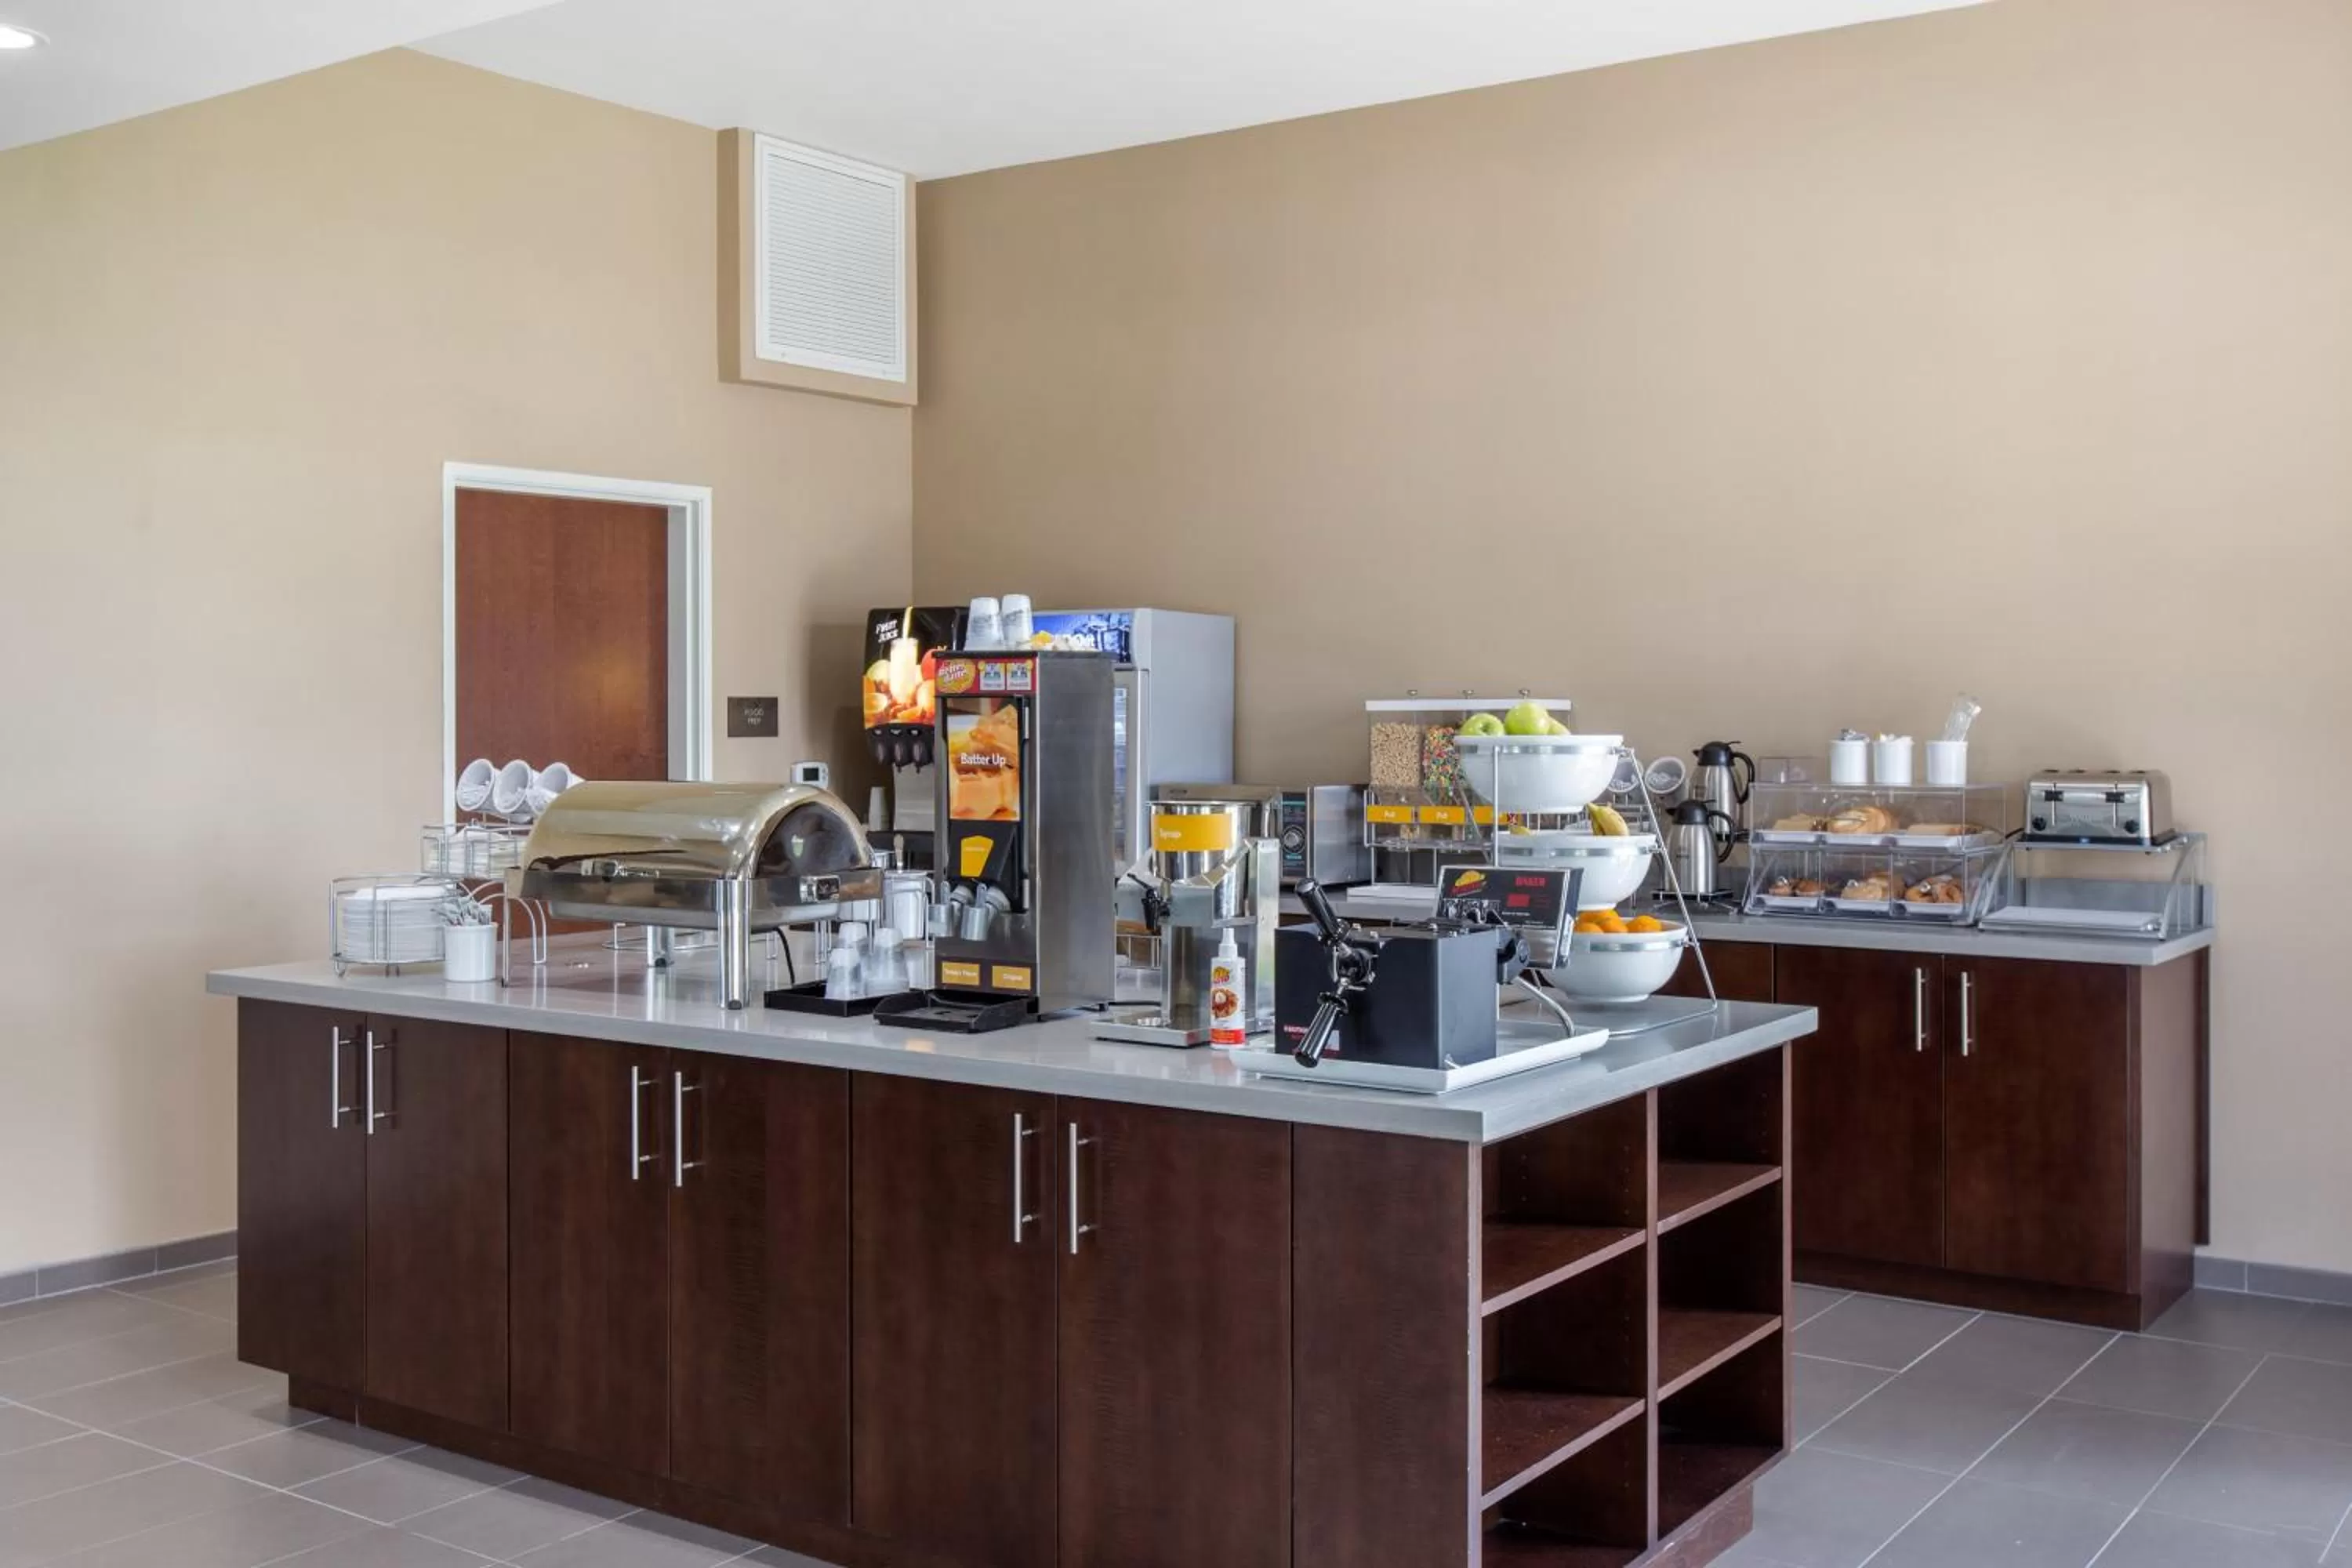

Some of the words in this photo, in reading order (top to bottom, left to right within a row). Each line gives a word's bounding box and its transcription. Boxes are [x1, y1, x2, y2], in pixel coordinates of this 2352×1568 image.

[878, 629, 898, 643] JUICE
[745, 708, 764, 717] FOOD
[960, 753, 990, 765] Batter
[992, 753, 1007, 768] Up
